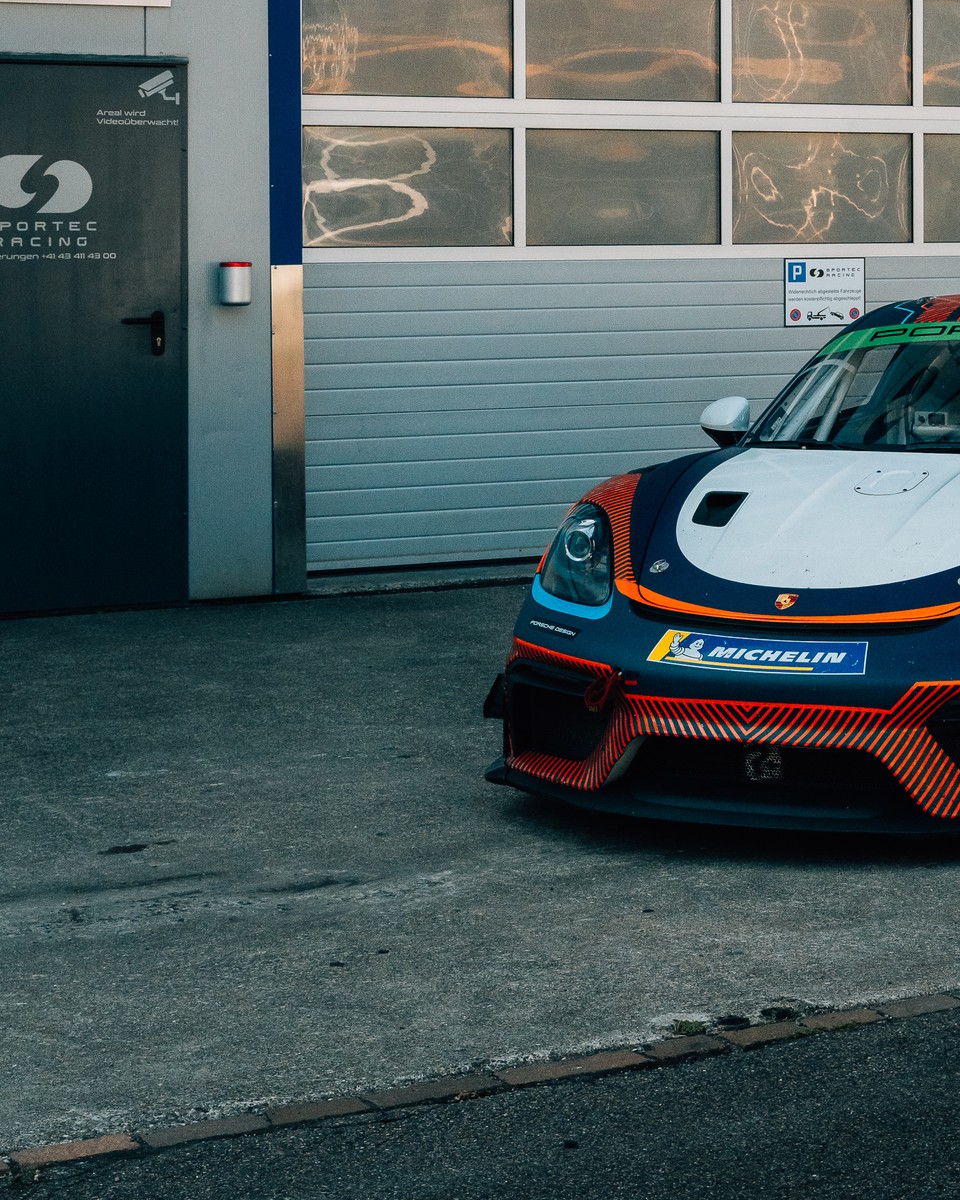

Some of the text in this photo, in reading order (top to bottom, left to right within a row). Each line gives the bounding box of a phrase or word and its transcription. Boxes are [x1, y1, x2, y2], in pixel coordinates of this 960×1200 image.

[96, 118, 179, 126] Videoüberwacht!
[793, 265, 802, 280] P
[530, 620, 555, 631] PORSCHE
[708, 646, 848, 664] MICHELIN
